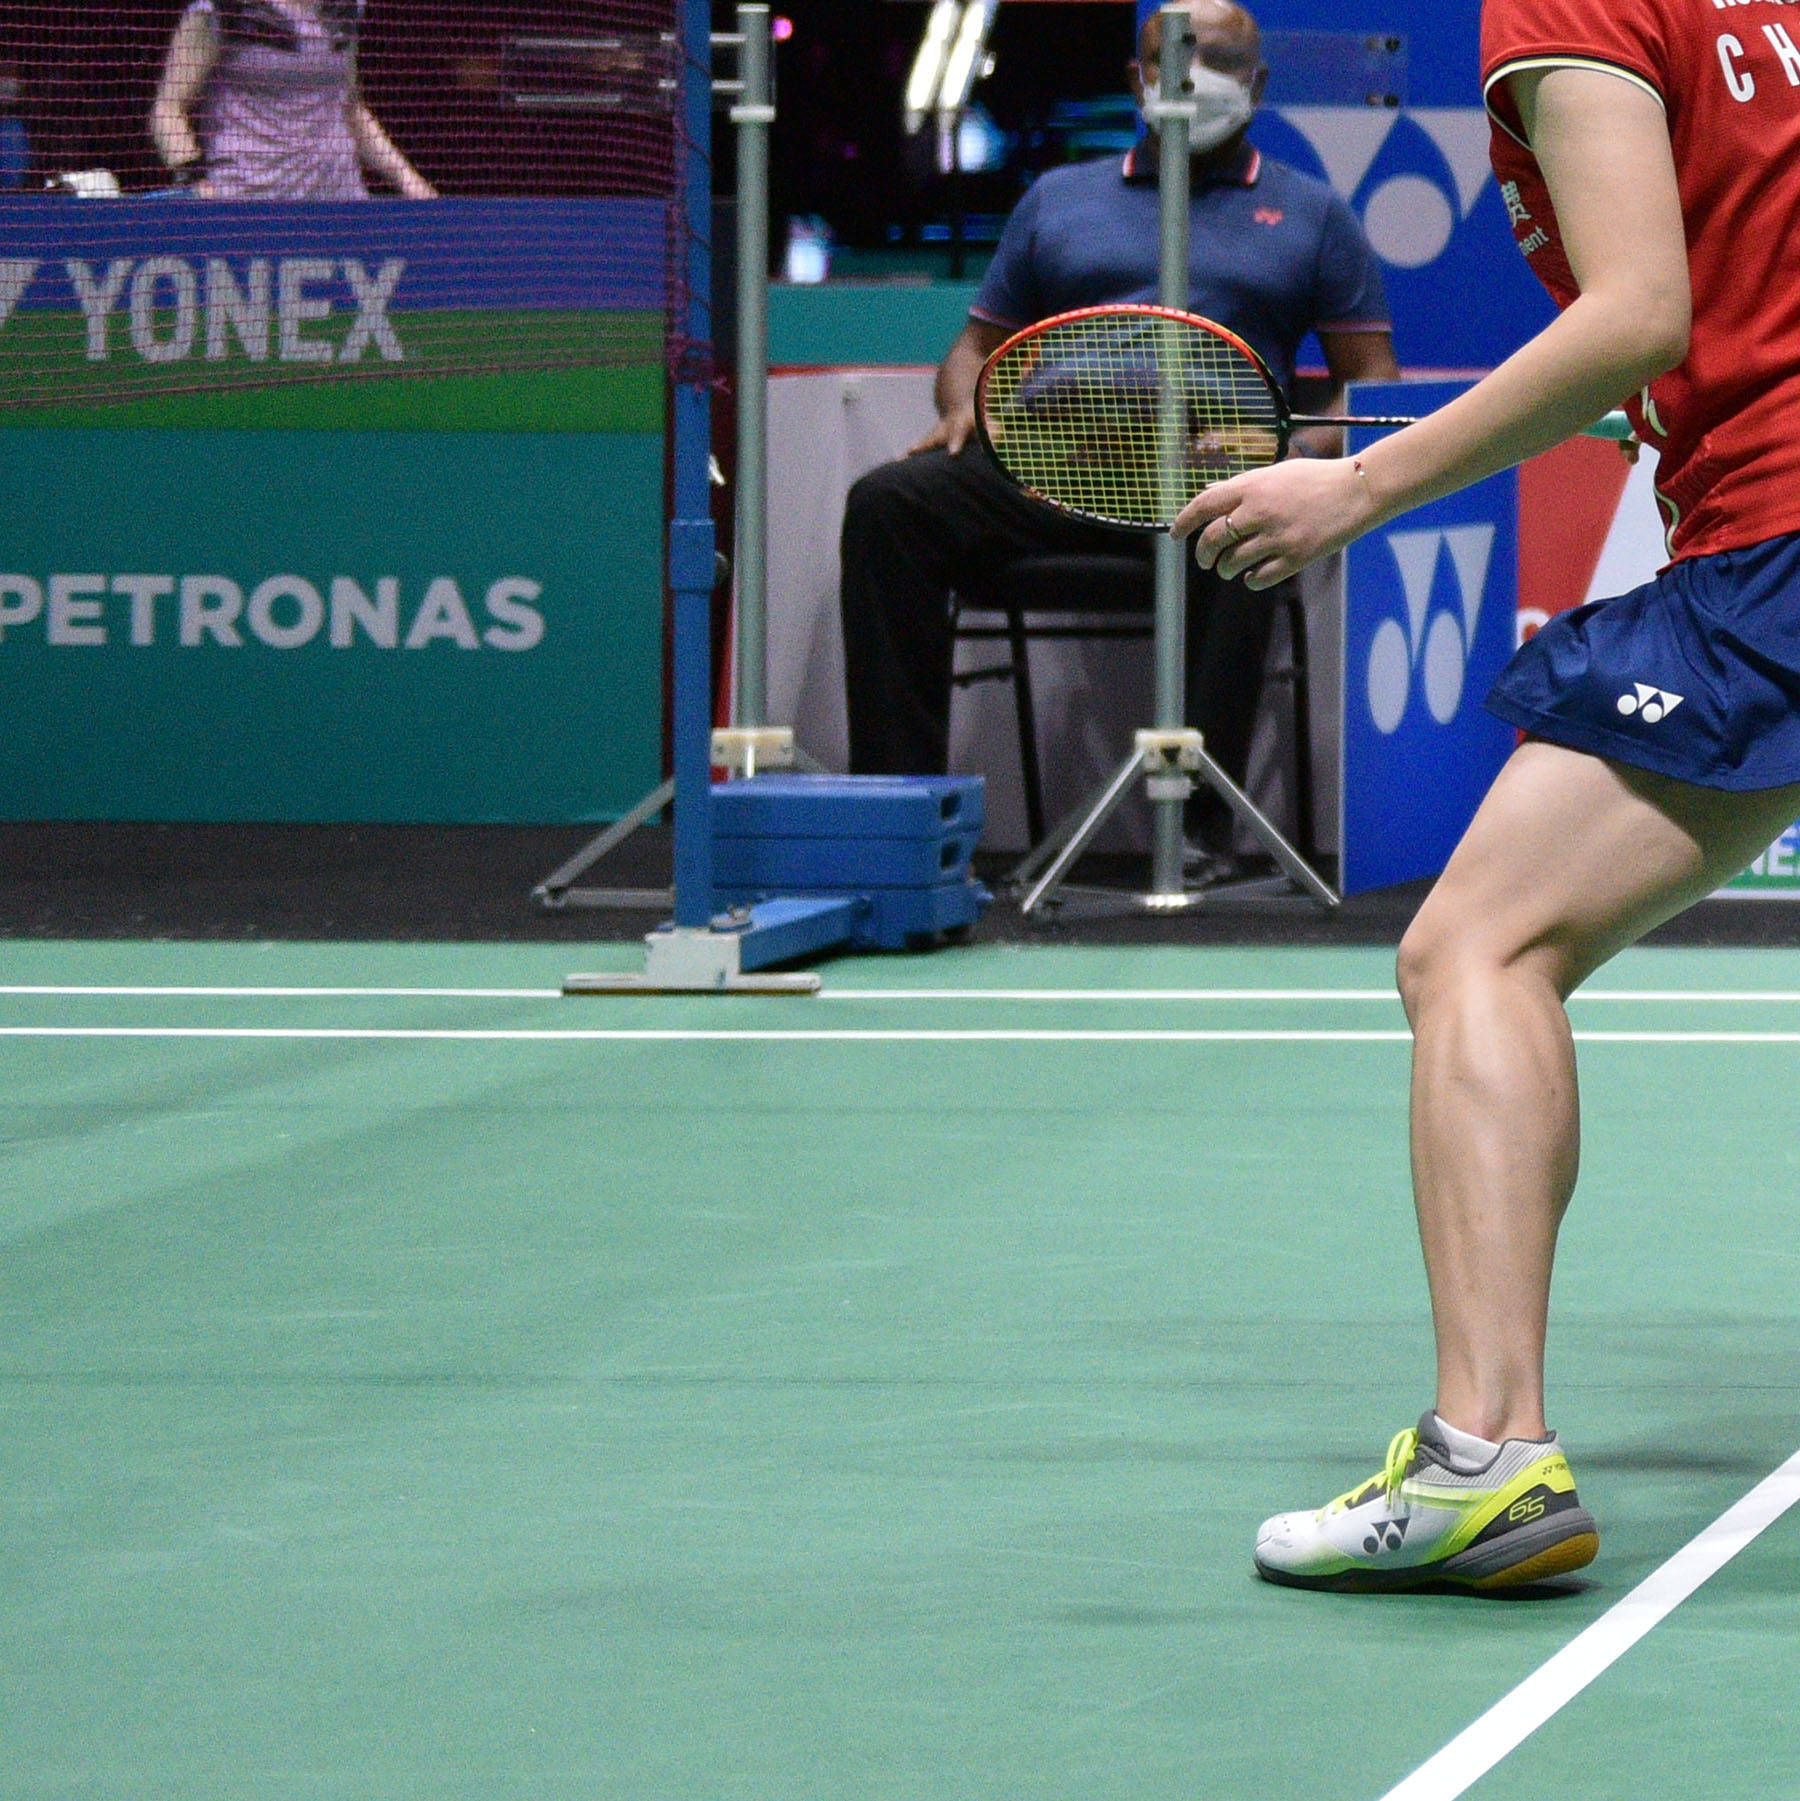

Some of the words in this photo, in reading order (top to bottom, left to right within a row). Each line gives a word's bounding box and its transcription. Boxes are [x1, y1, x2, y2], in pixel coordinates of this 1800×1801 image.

[67, 258, 407, 363] YONEX
[0, 574, 546, 650] PETRONAS
[1508, 1495, 1546, 1523] 65
